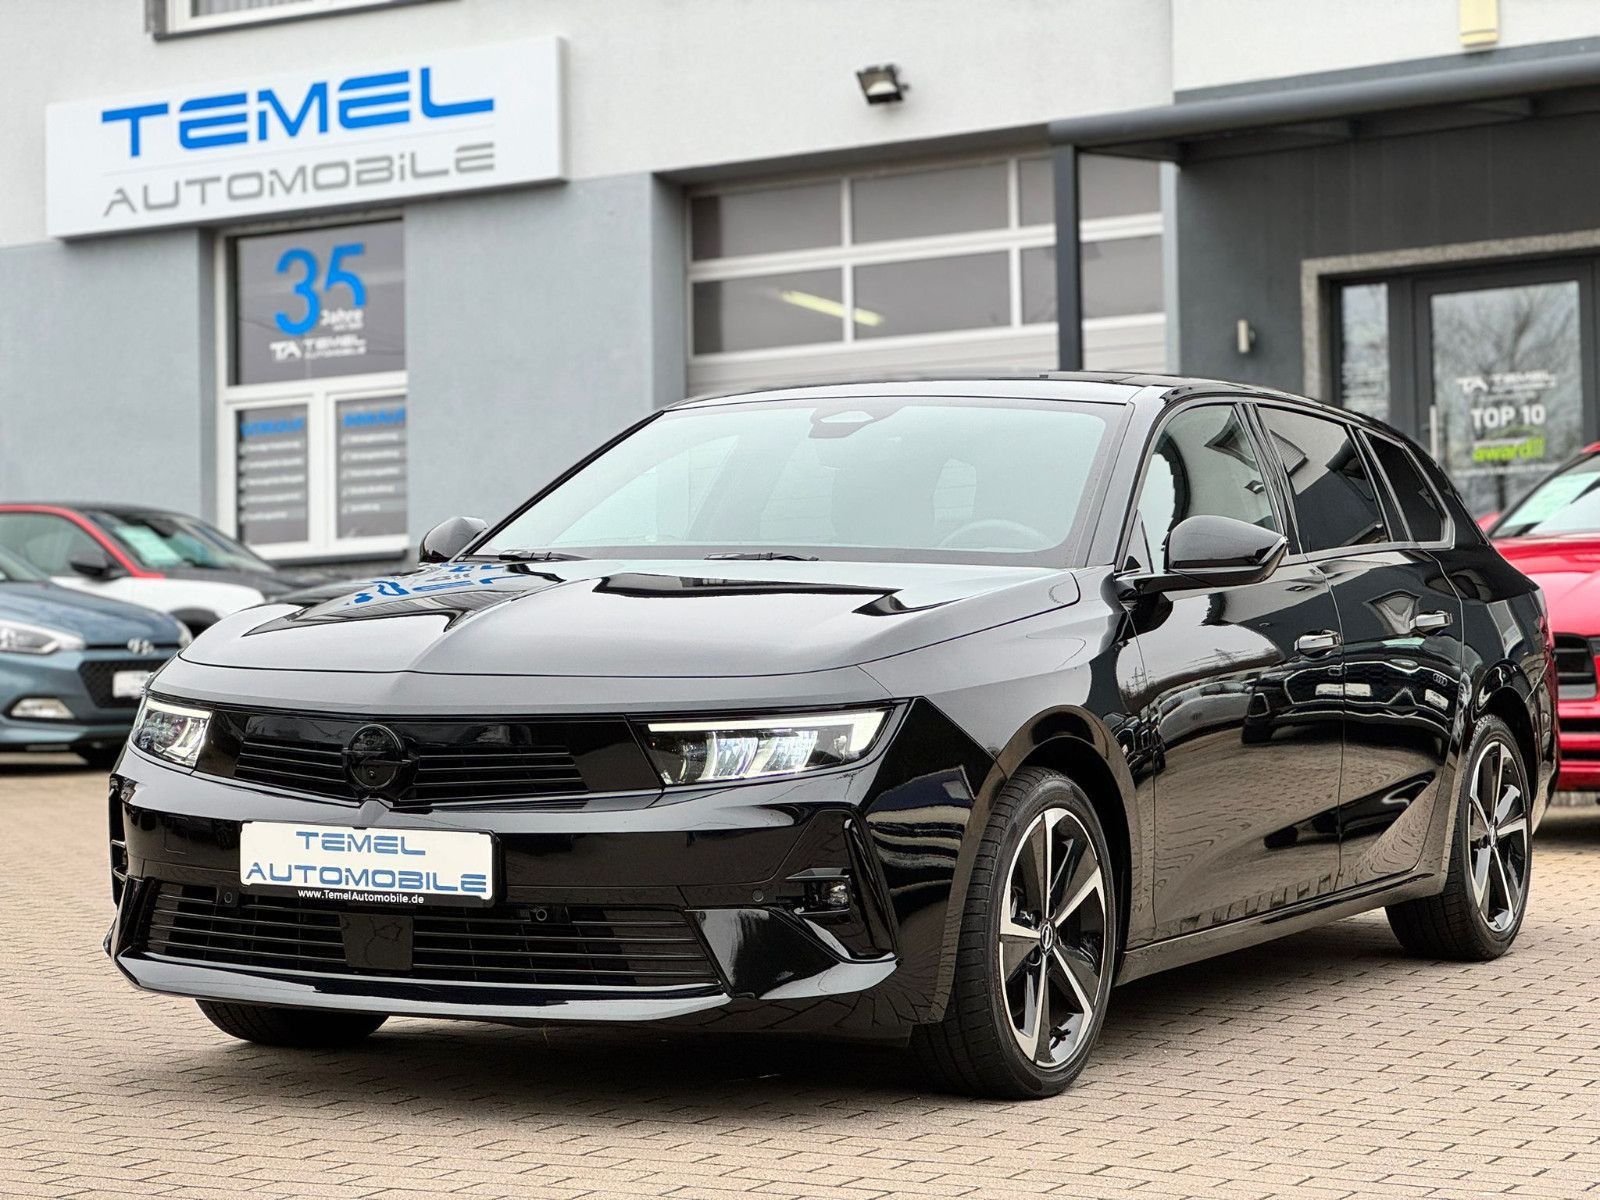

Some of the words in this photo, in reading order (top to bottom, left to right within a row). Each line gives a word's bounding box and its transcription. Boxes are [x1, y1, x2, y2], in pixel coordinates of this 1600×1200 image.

[101, 66, 494, 157] TEMEL
[275, 243, 366, 335] 35
[1471, 405, 1516, 430] TOP
[1521, 404, 1546, 425] 10
[296, 831, 426, 856] TEMEL
[246, 862, 487, 893] AUTOMOBILE
[297, 889, 424, 904] www.TemelAutomobile.de
